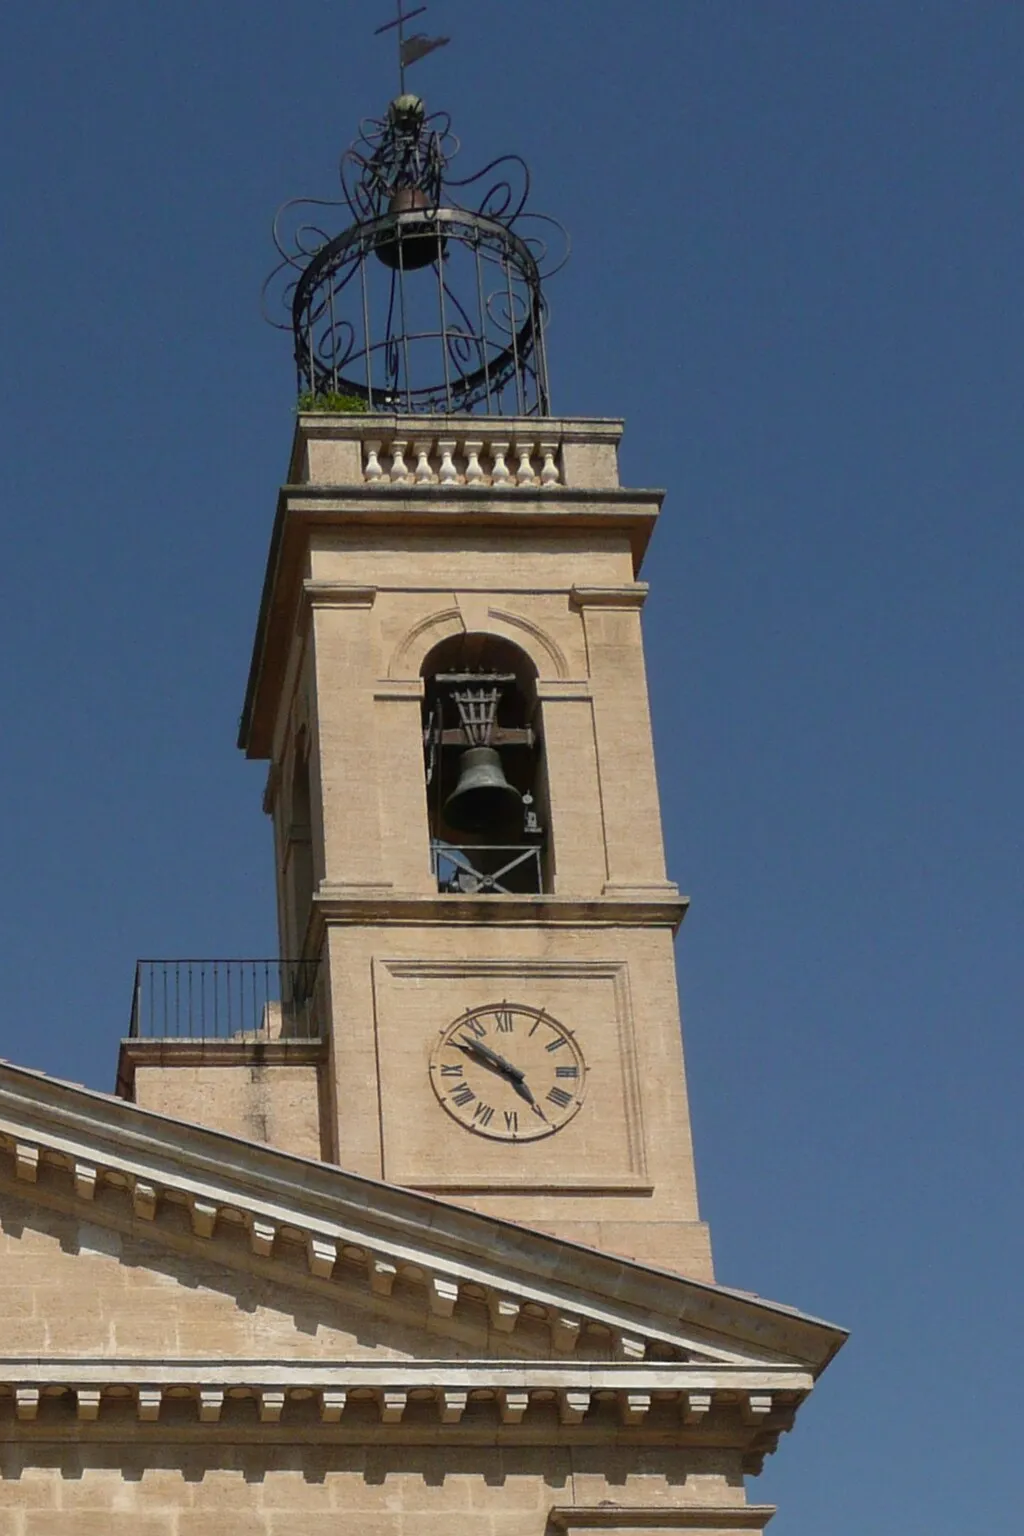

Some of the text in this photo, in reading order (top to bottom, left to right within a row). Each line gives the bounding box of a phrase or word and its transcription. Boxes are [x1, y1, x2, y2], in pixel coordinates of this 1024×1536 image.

[465, 1017, 487, 1038] XI
[495, 1012, 513, 1032] XII
[545, 1037, 567, 1053] II
[440, 1064, 463, 1077] IX
[556, 1066, 578, 1078] III
[448, 1082, 476, 1107] VIII
[545, 1086, 573, 1110] IIII
[473, 1102, 495, 1127] VII
[504, 1111, 518, 1132] VI
